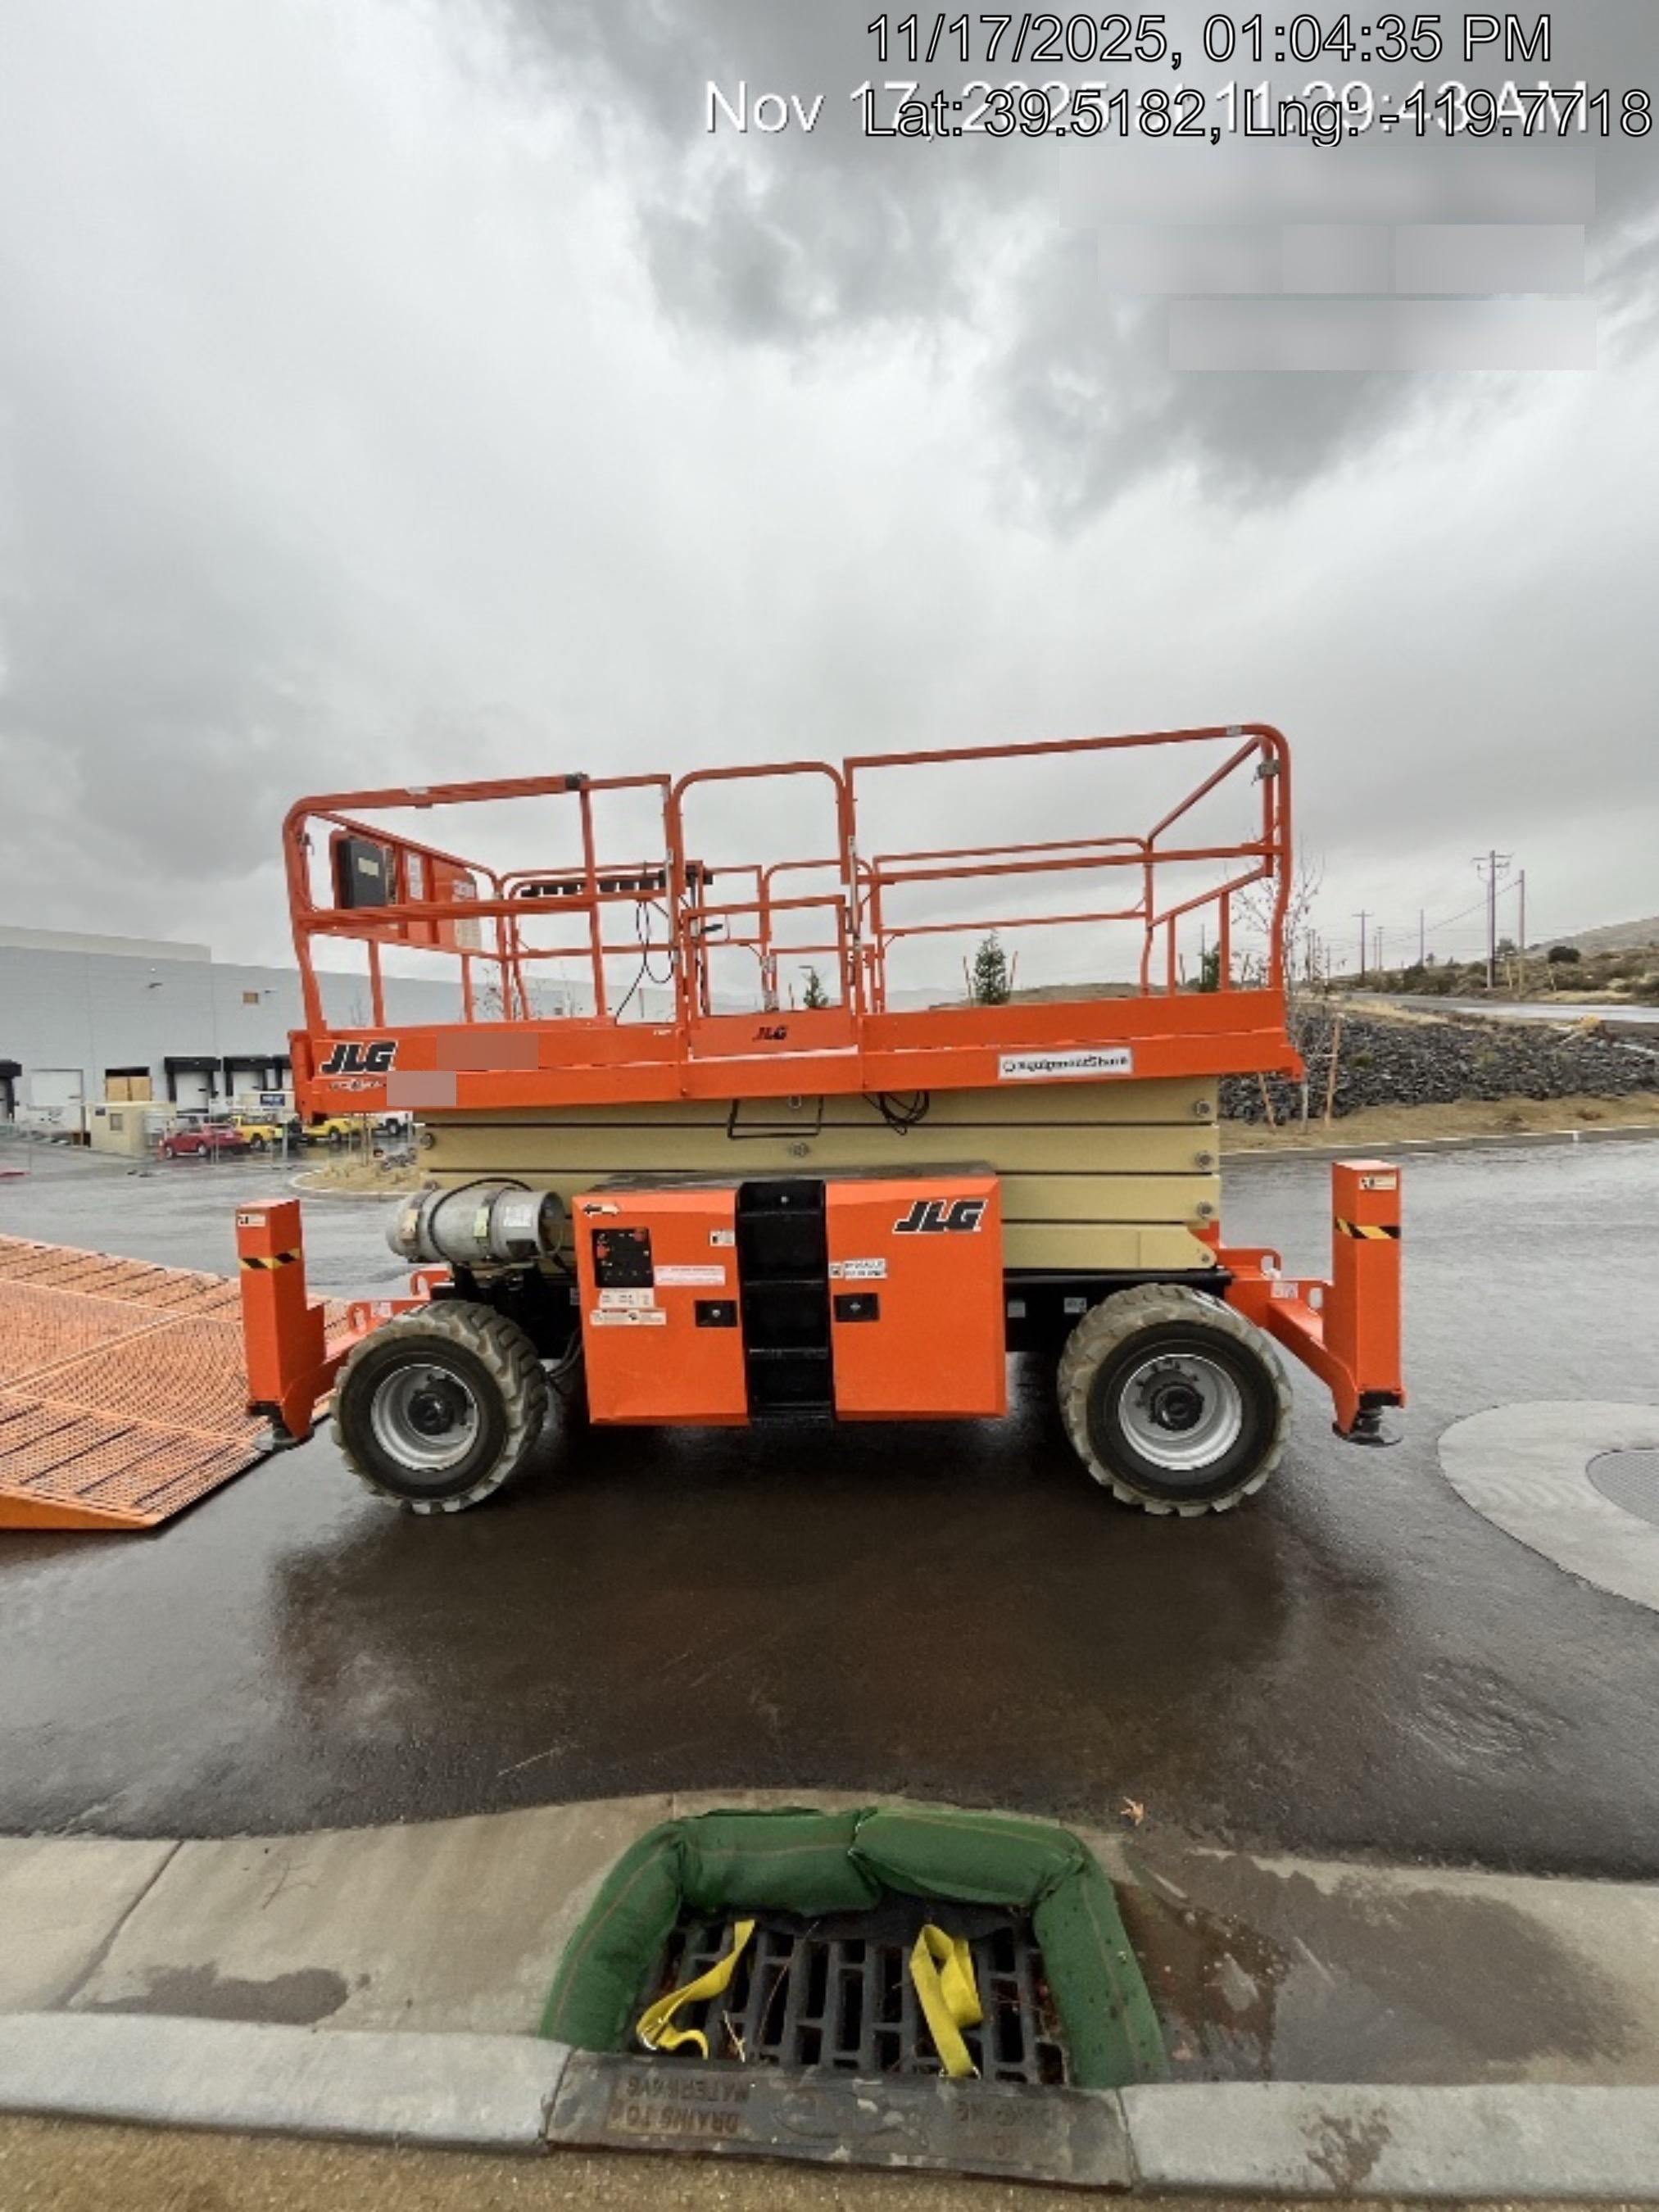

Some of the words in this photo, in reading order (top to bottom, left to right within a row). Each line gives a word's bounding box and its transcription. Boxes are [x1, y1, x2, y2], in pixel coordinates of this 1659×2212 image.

[752, 1025, 788, 1041] JLG
[320, 1040, 397, 1075] JLG
[892, 1199, 989, 1235] JLG
